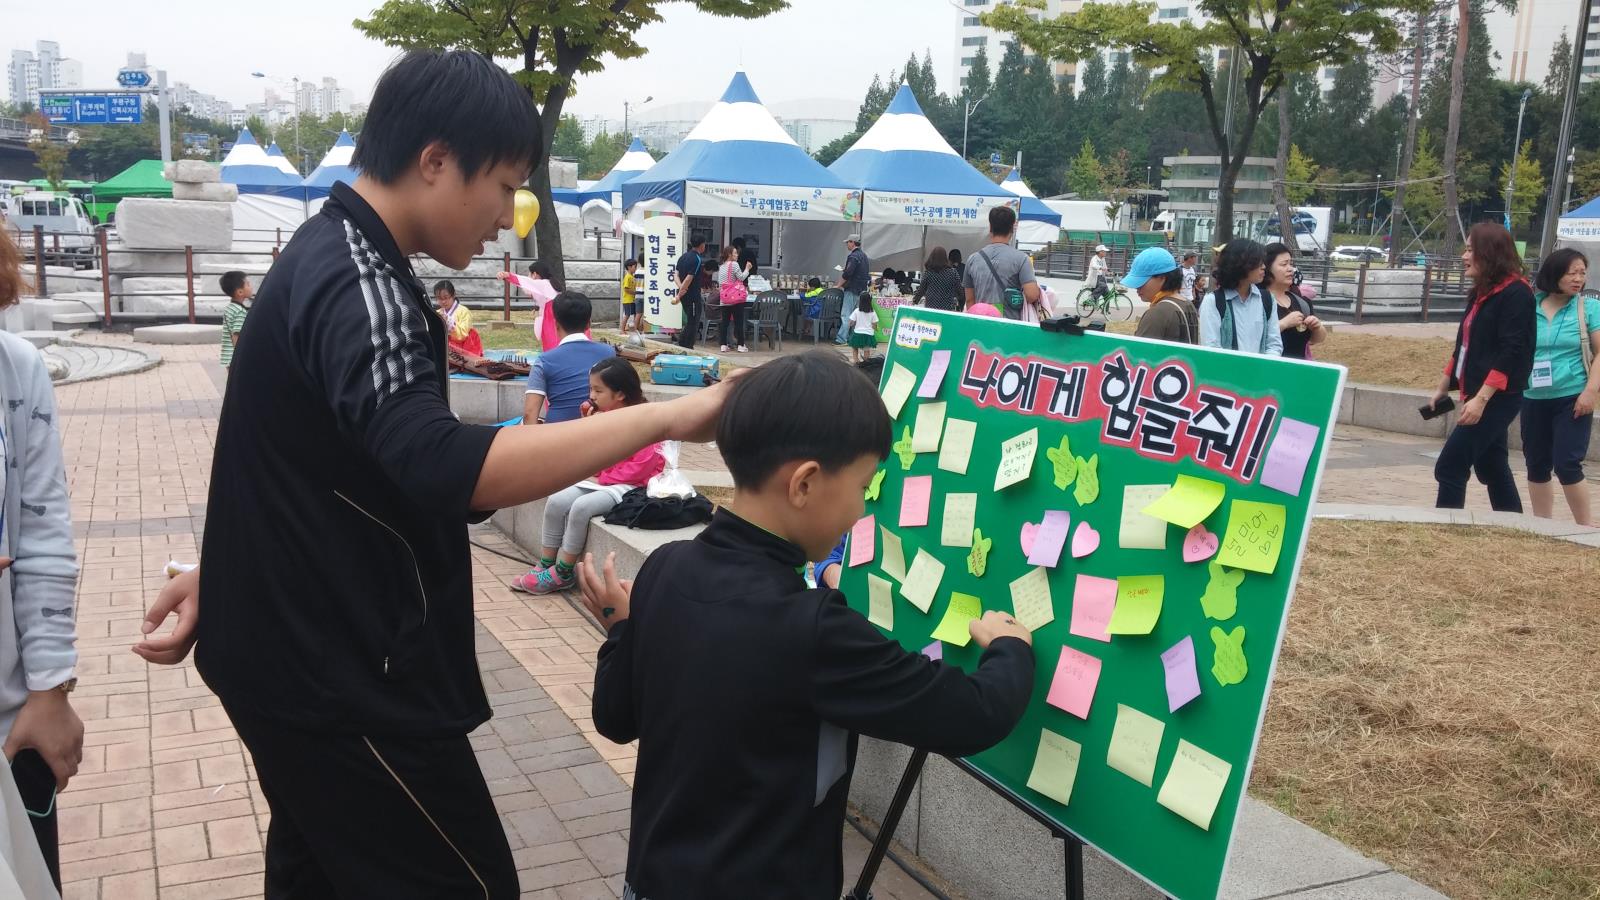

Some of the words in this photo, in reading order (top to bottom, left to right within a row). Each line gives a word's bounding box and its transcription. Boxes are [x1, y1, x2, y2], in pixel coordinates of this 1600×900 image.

[740, 197, 808, 211] 느루공예협동조합
[904, 205, 943, 218] 비즈수공예
[945, 206, 960, 219] 팔찌
[962, 207, 977, 219] 체험
[648, 234, 661, 315] 협동조합
[664, 228, 679, 298] 느루공예
[962, 347, 1088, 418] 나에게
